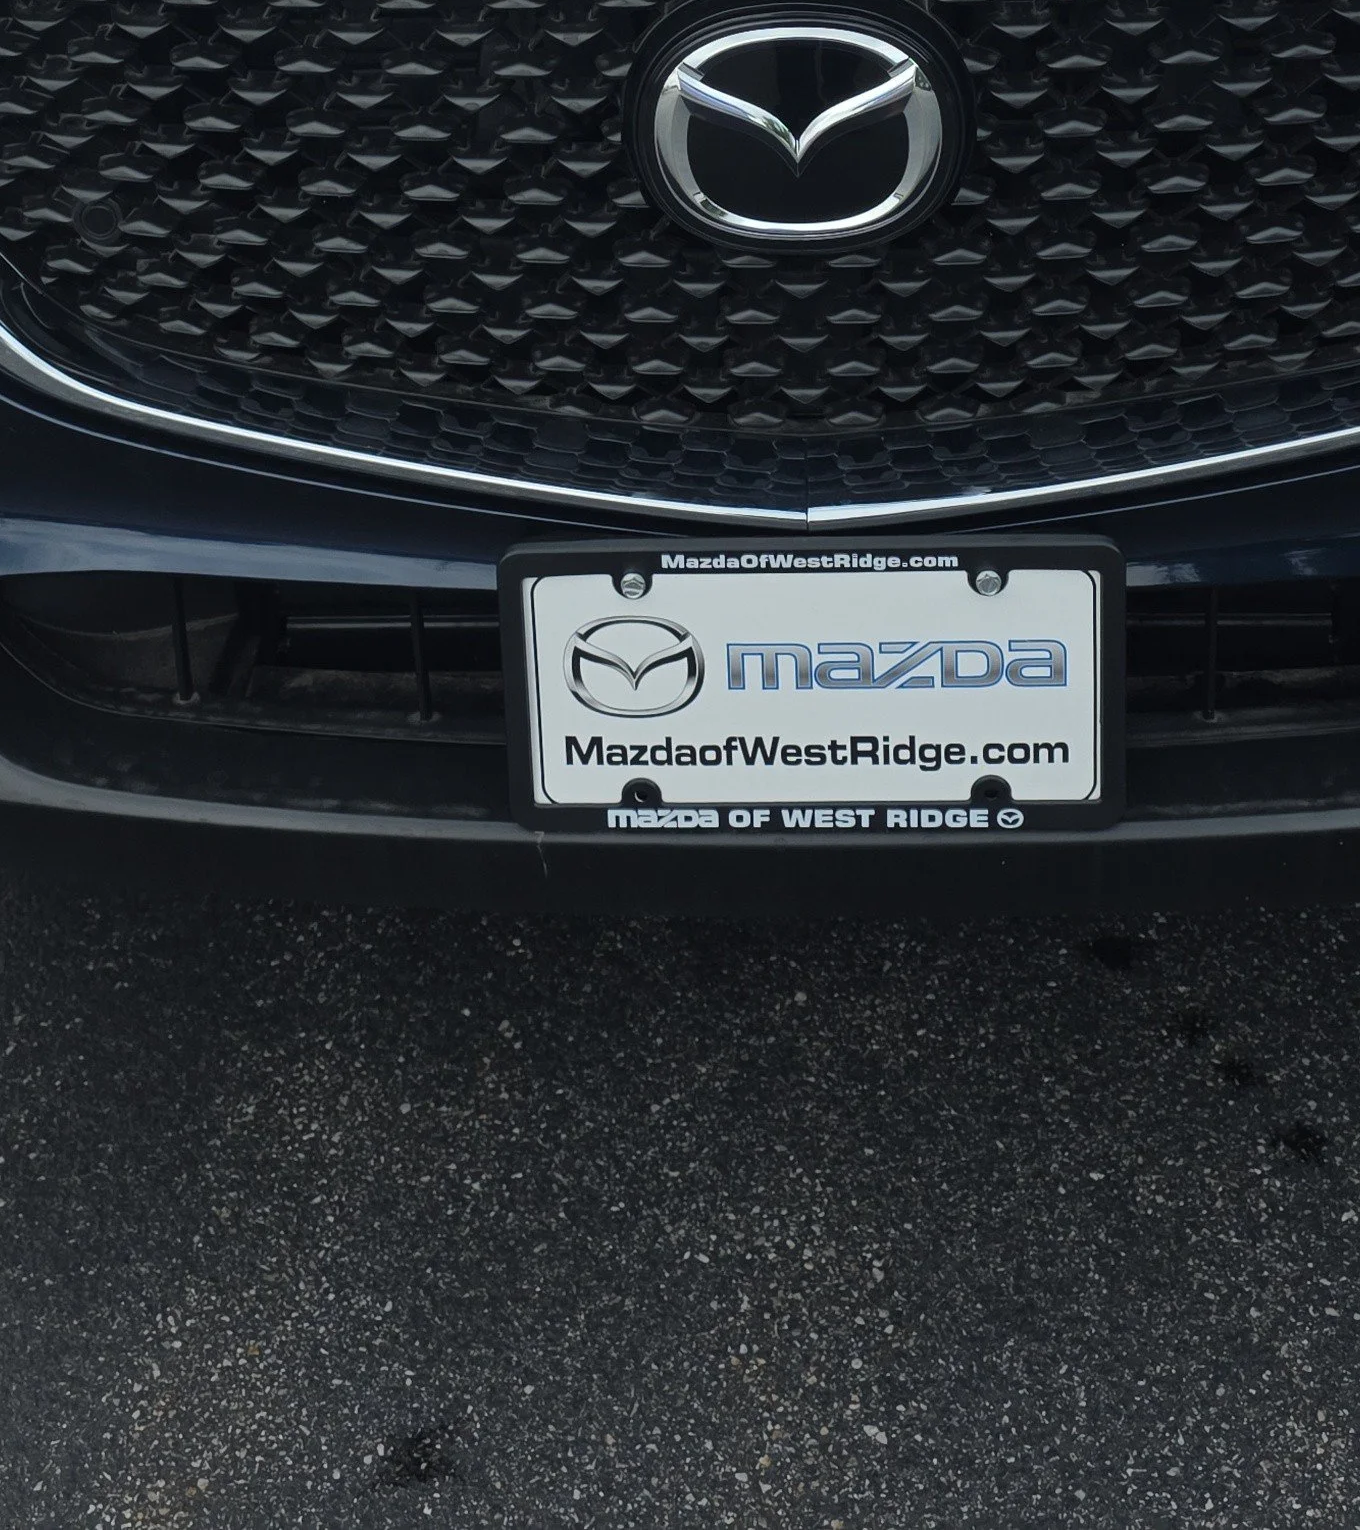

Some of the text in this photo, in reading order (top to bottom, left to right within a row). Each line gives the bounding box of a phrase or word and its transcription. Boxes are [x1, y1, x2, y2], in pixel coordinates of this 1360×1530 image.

[660, 553, 959, 570] MazdaOfWestRidge.com
[564, 734, 1070, 771] MazdaofWestRidge.com
[728, 808, 771, 828] OF
[782, 808, 875, 828] WEST
[886, 808, 989, 828] RIDGE
